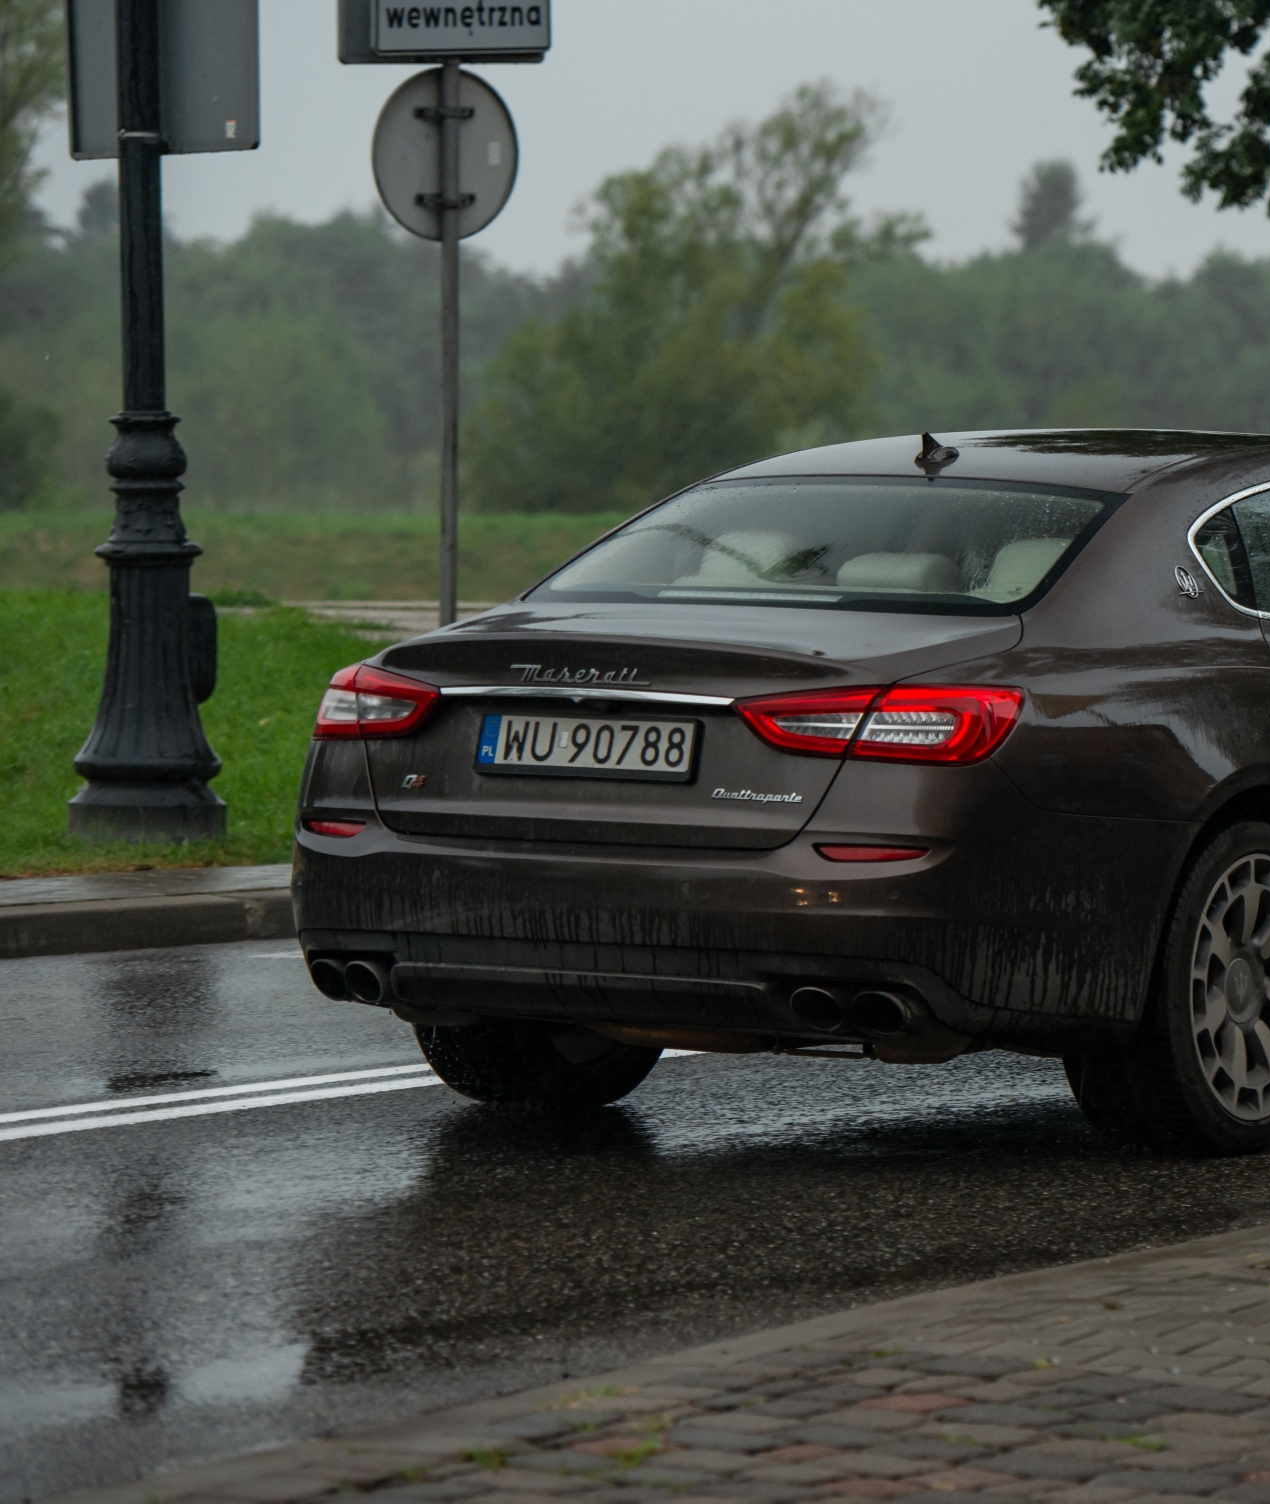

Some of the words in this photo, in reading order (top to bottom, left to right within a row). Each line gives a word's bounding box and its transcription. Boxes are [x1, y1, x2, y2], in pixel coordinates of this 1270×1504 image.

[386, 0, 541, 36] wewnętrzna
[510, 663, 650, 686] Maserati
[481, 745, 494, 757] PL
[503, 720, 558, 762] WU
[567, 723, 686, 767] 90788
[711, 788, 803, 805] Quattroporte
